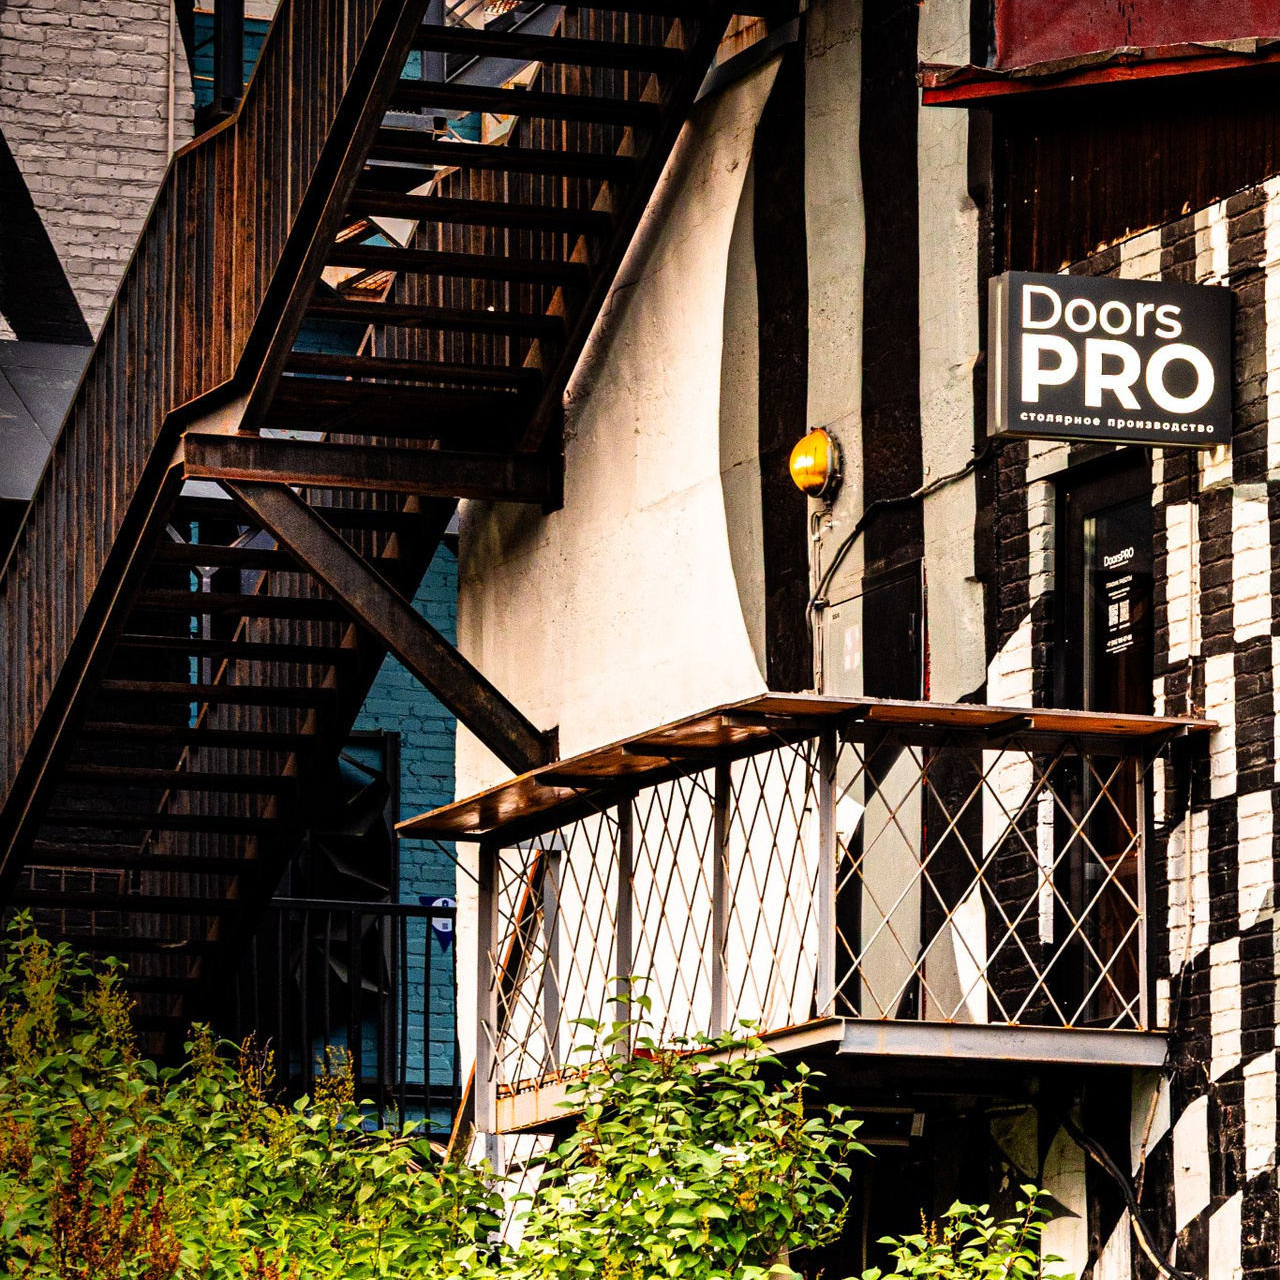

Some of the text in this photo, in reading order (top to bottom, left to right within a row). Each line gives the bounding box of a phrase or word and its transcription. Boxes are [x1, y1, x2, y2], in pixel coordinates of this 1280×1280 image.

[1021, 284, 1183, 339] Doors
[1020, 333, 1215, 414] PRO
[1020, 412, 1215, 433] столярное производство
